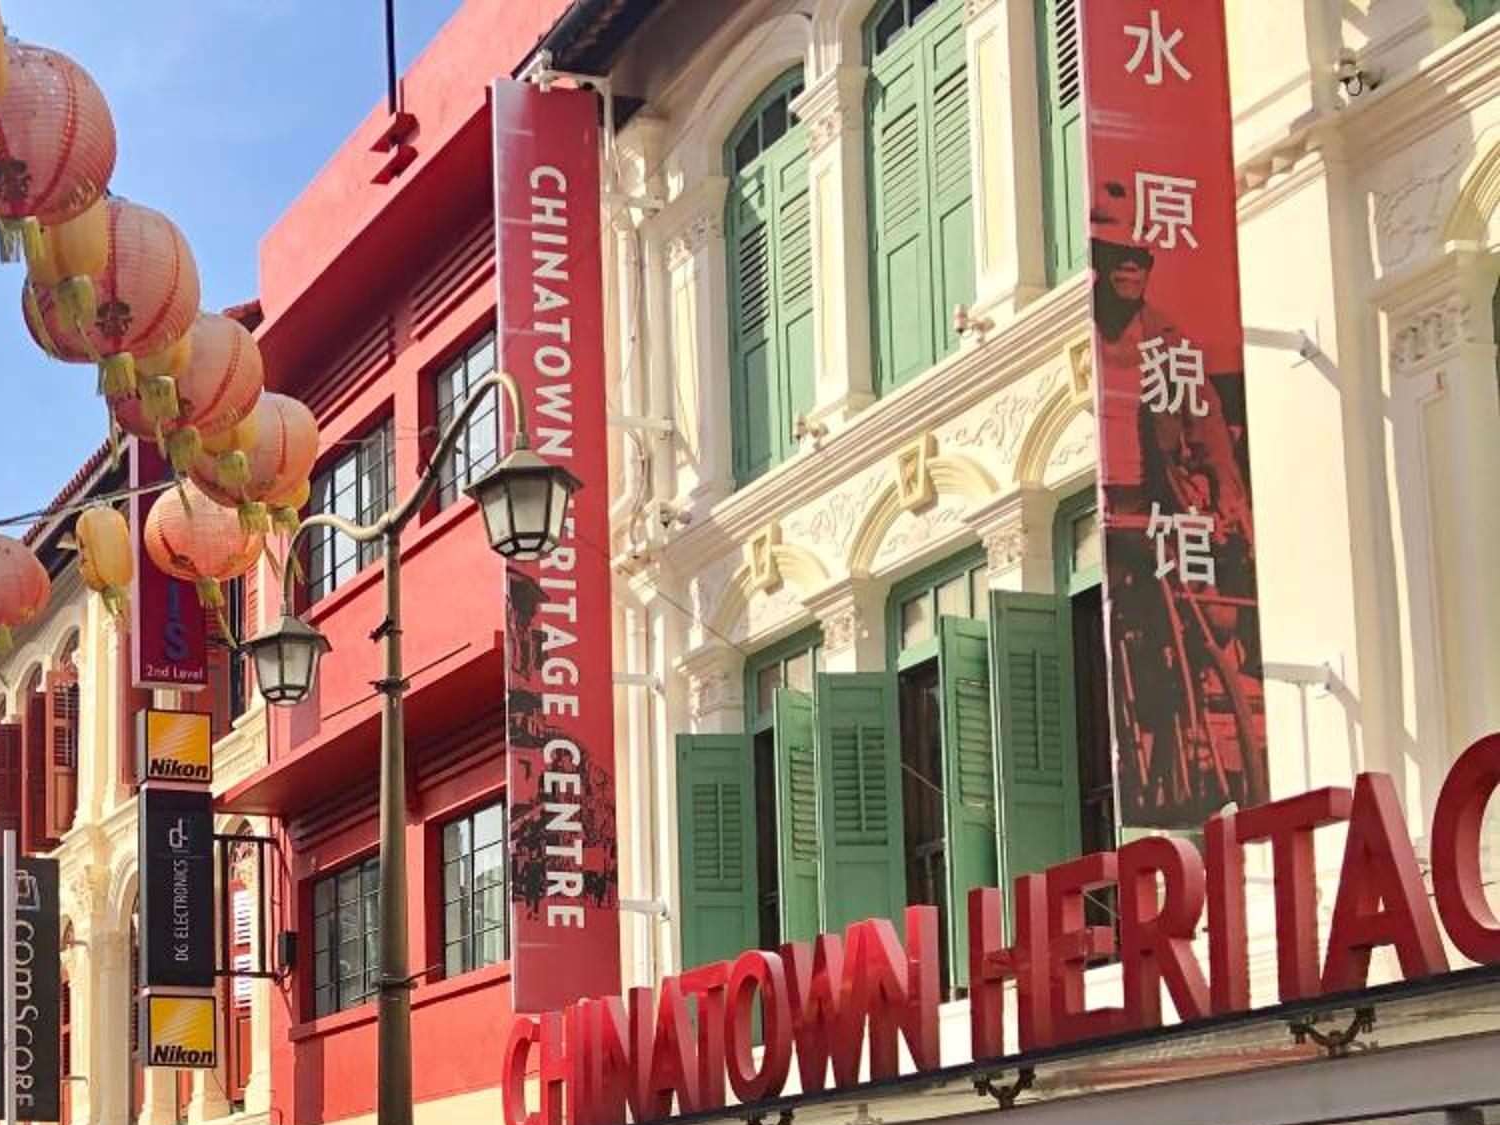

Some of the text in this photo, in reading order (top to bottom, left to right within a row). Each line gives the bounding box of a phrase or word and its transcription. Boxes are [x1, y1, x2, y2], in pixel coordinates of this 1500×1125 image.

[1123, 9, 1218, 588] 水原貌馆
[528, 164, 585, 930] CHINATOWN RITAGE CENTRE
[147, 664, 203, 681] 2nd Level
[150, 758, 209, 778] Nikon
[173, 859, 190, 961] DG ELECTRONICS
[153, 1045, 213, 1065] Nikon
